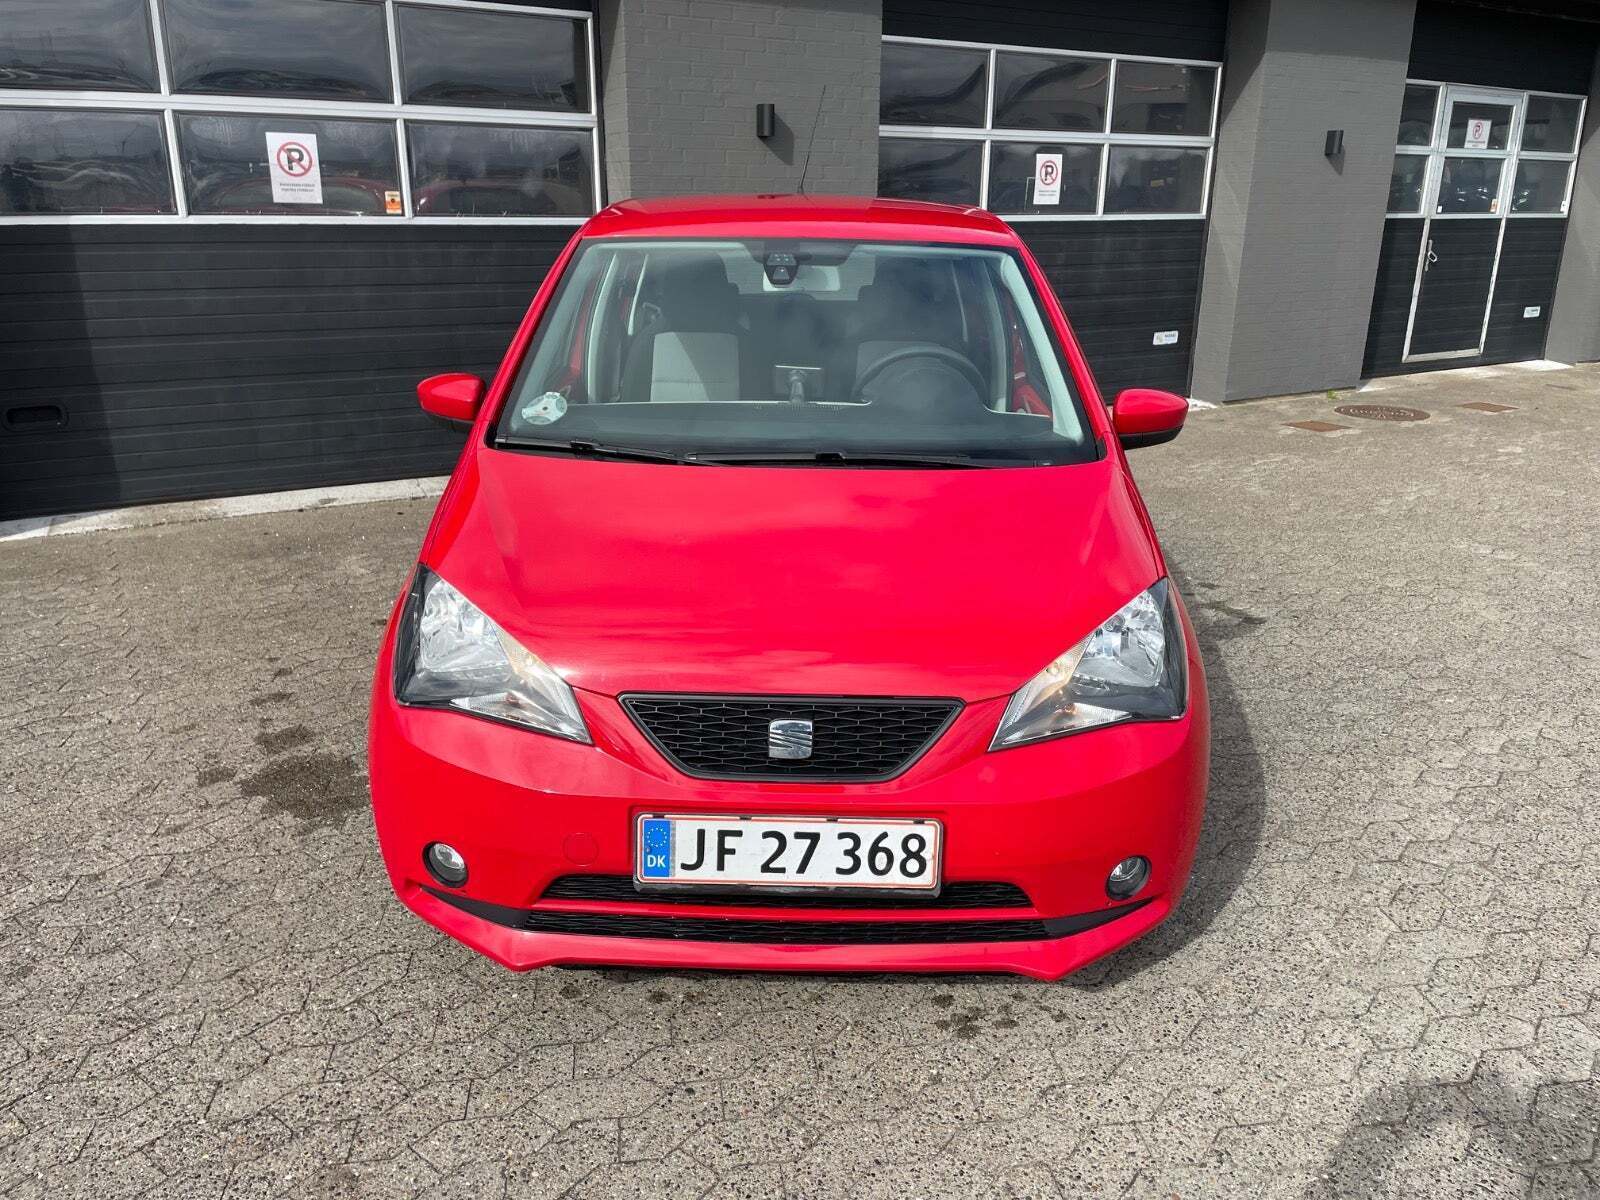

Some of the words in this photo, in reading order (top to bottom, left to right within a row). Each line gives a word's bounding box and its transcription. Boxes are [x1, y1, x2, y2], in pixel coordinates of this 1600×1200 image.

[647, 854, 666, 868] DK
[680, 828, 743, 872] JF
[760, 830, 821, 874] 27
[835, 831, 927, 878] 368
